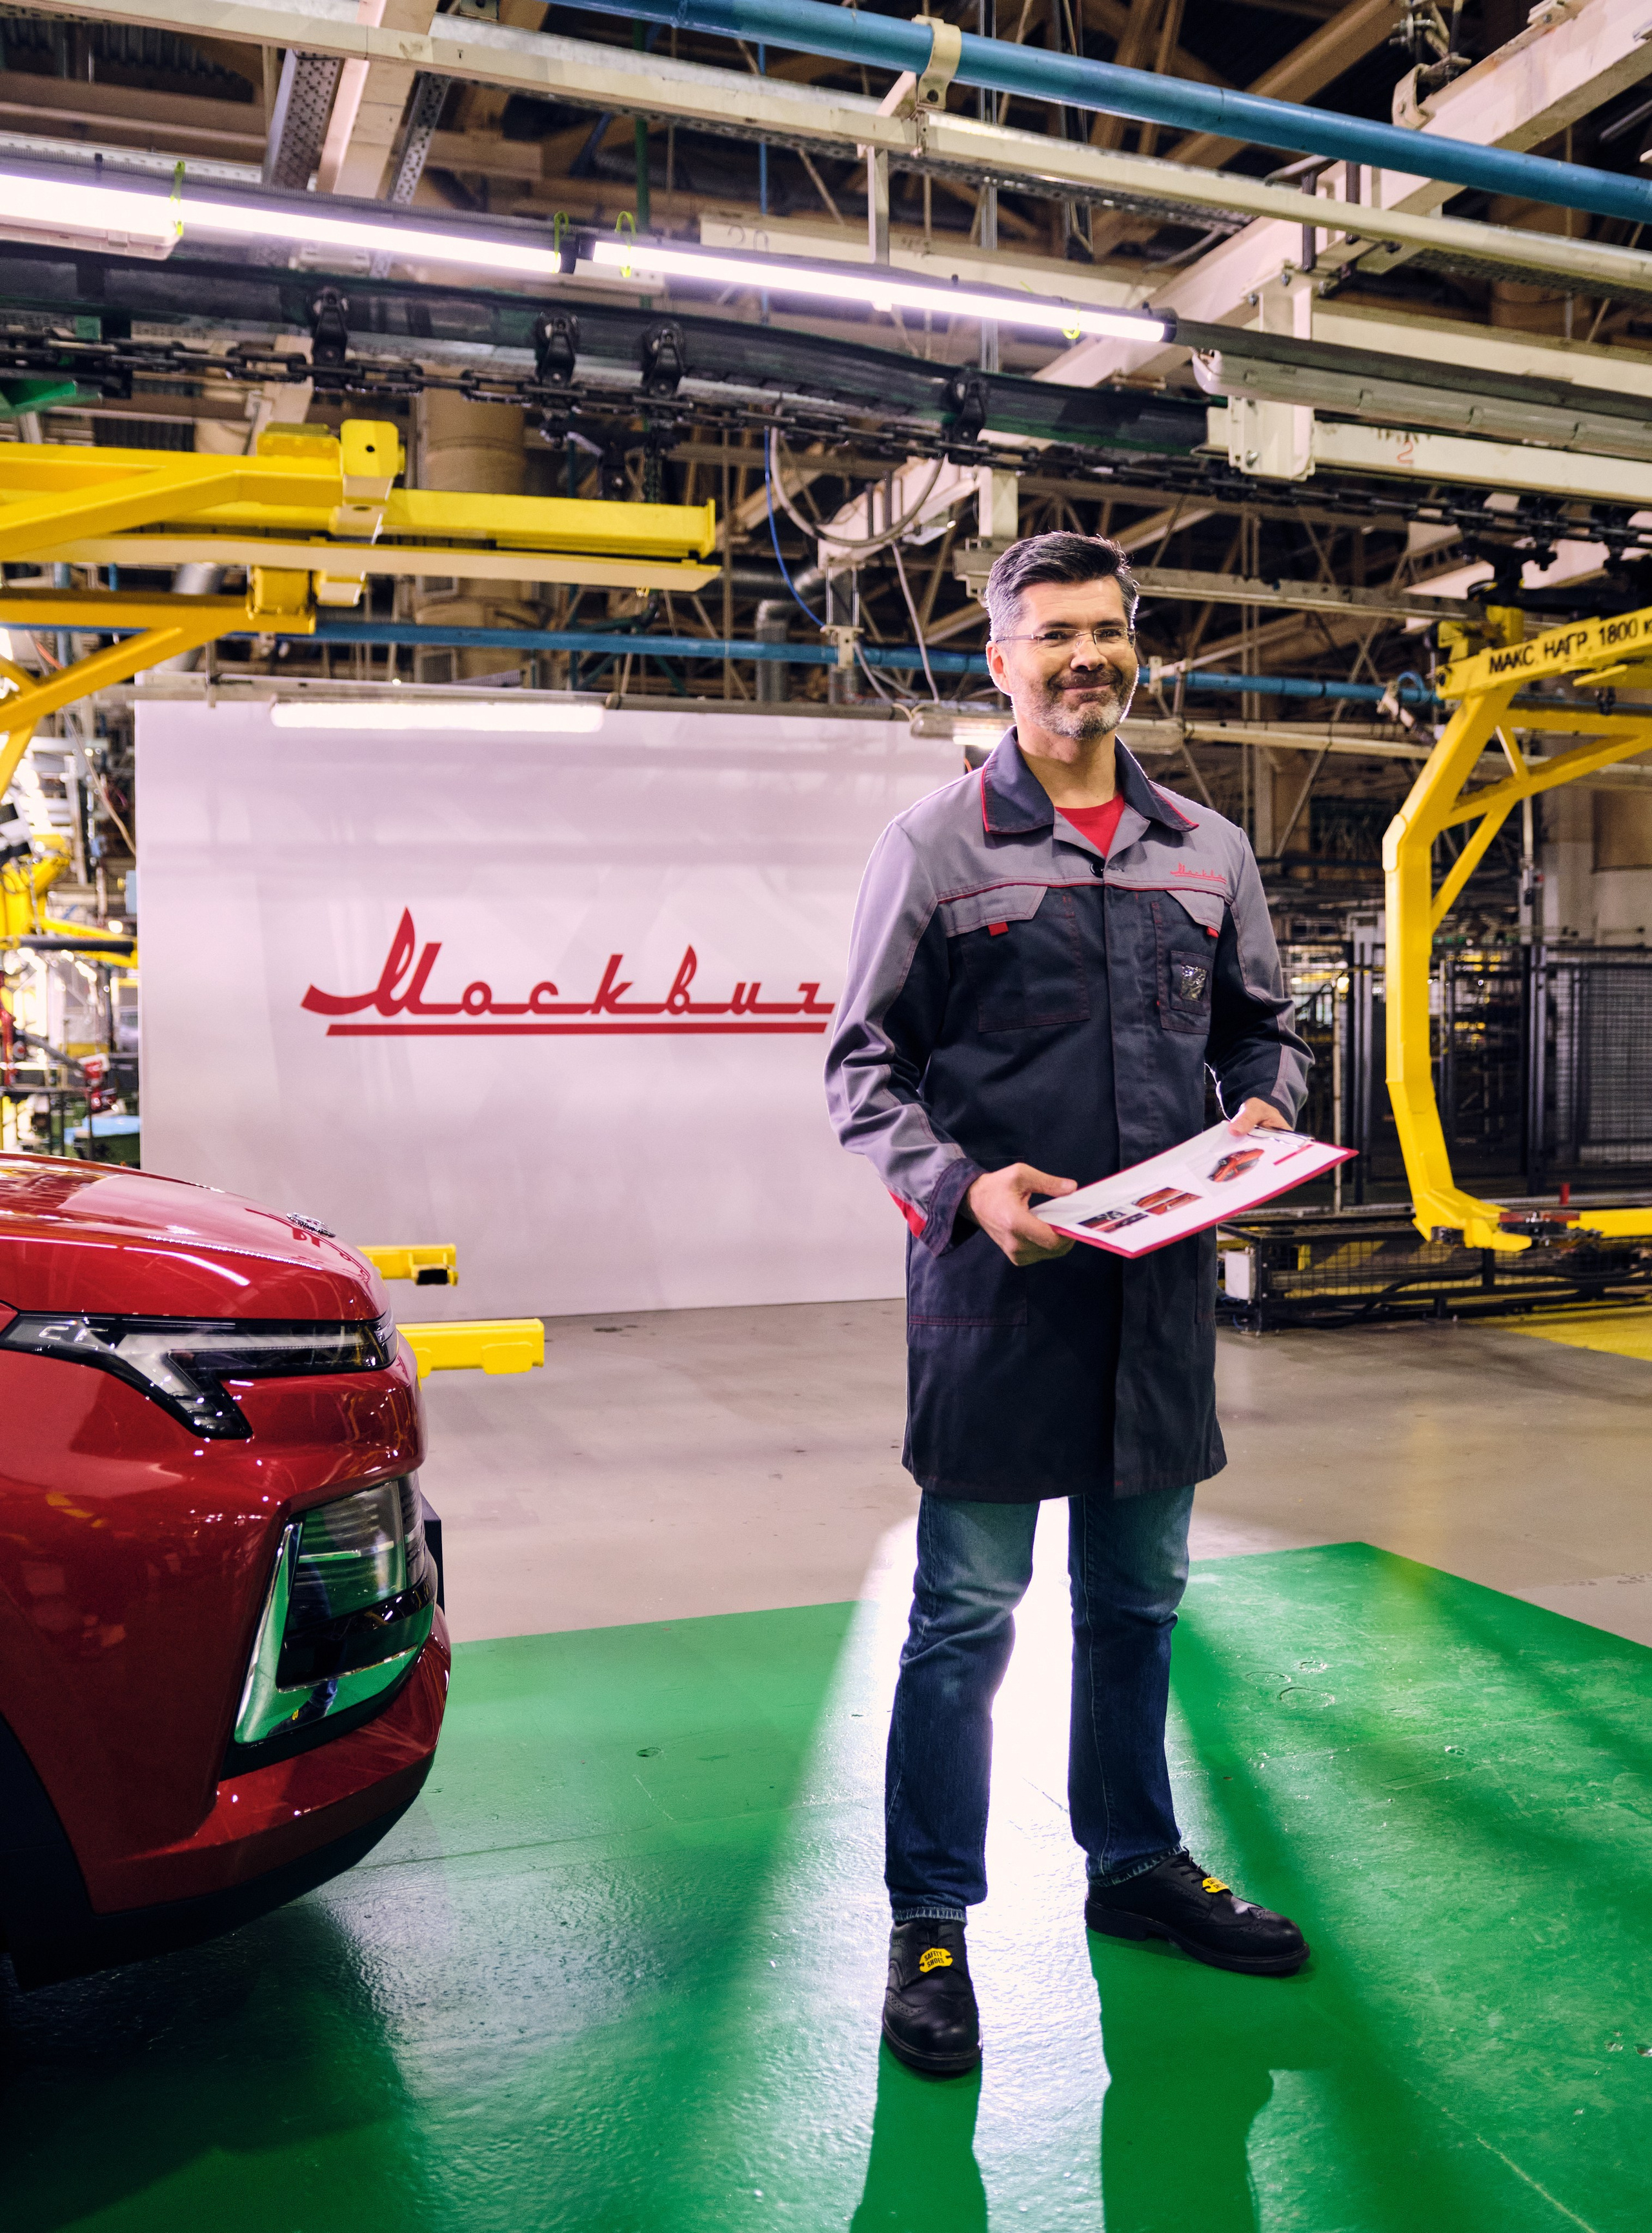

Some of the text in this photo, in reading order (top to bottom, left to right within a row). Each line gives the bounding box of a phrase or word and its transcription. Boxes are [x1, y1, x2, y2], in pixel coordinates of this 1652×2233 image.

[1599, 618, 1638, 645] 1800
[924, 1951, 942, 1961] SAFETY
[927, 1958, 944, 1968] SHOES
